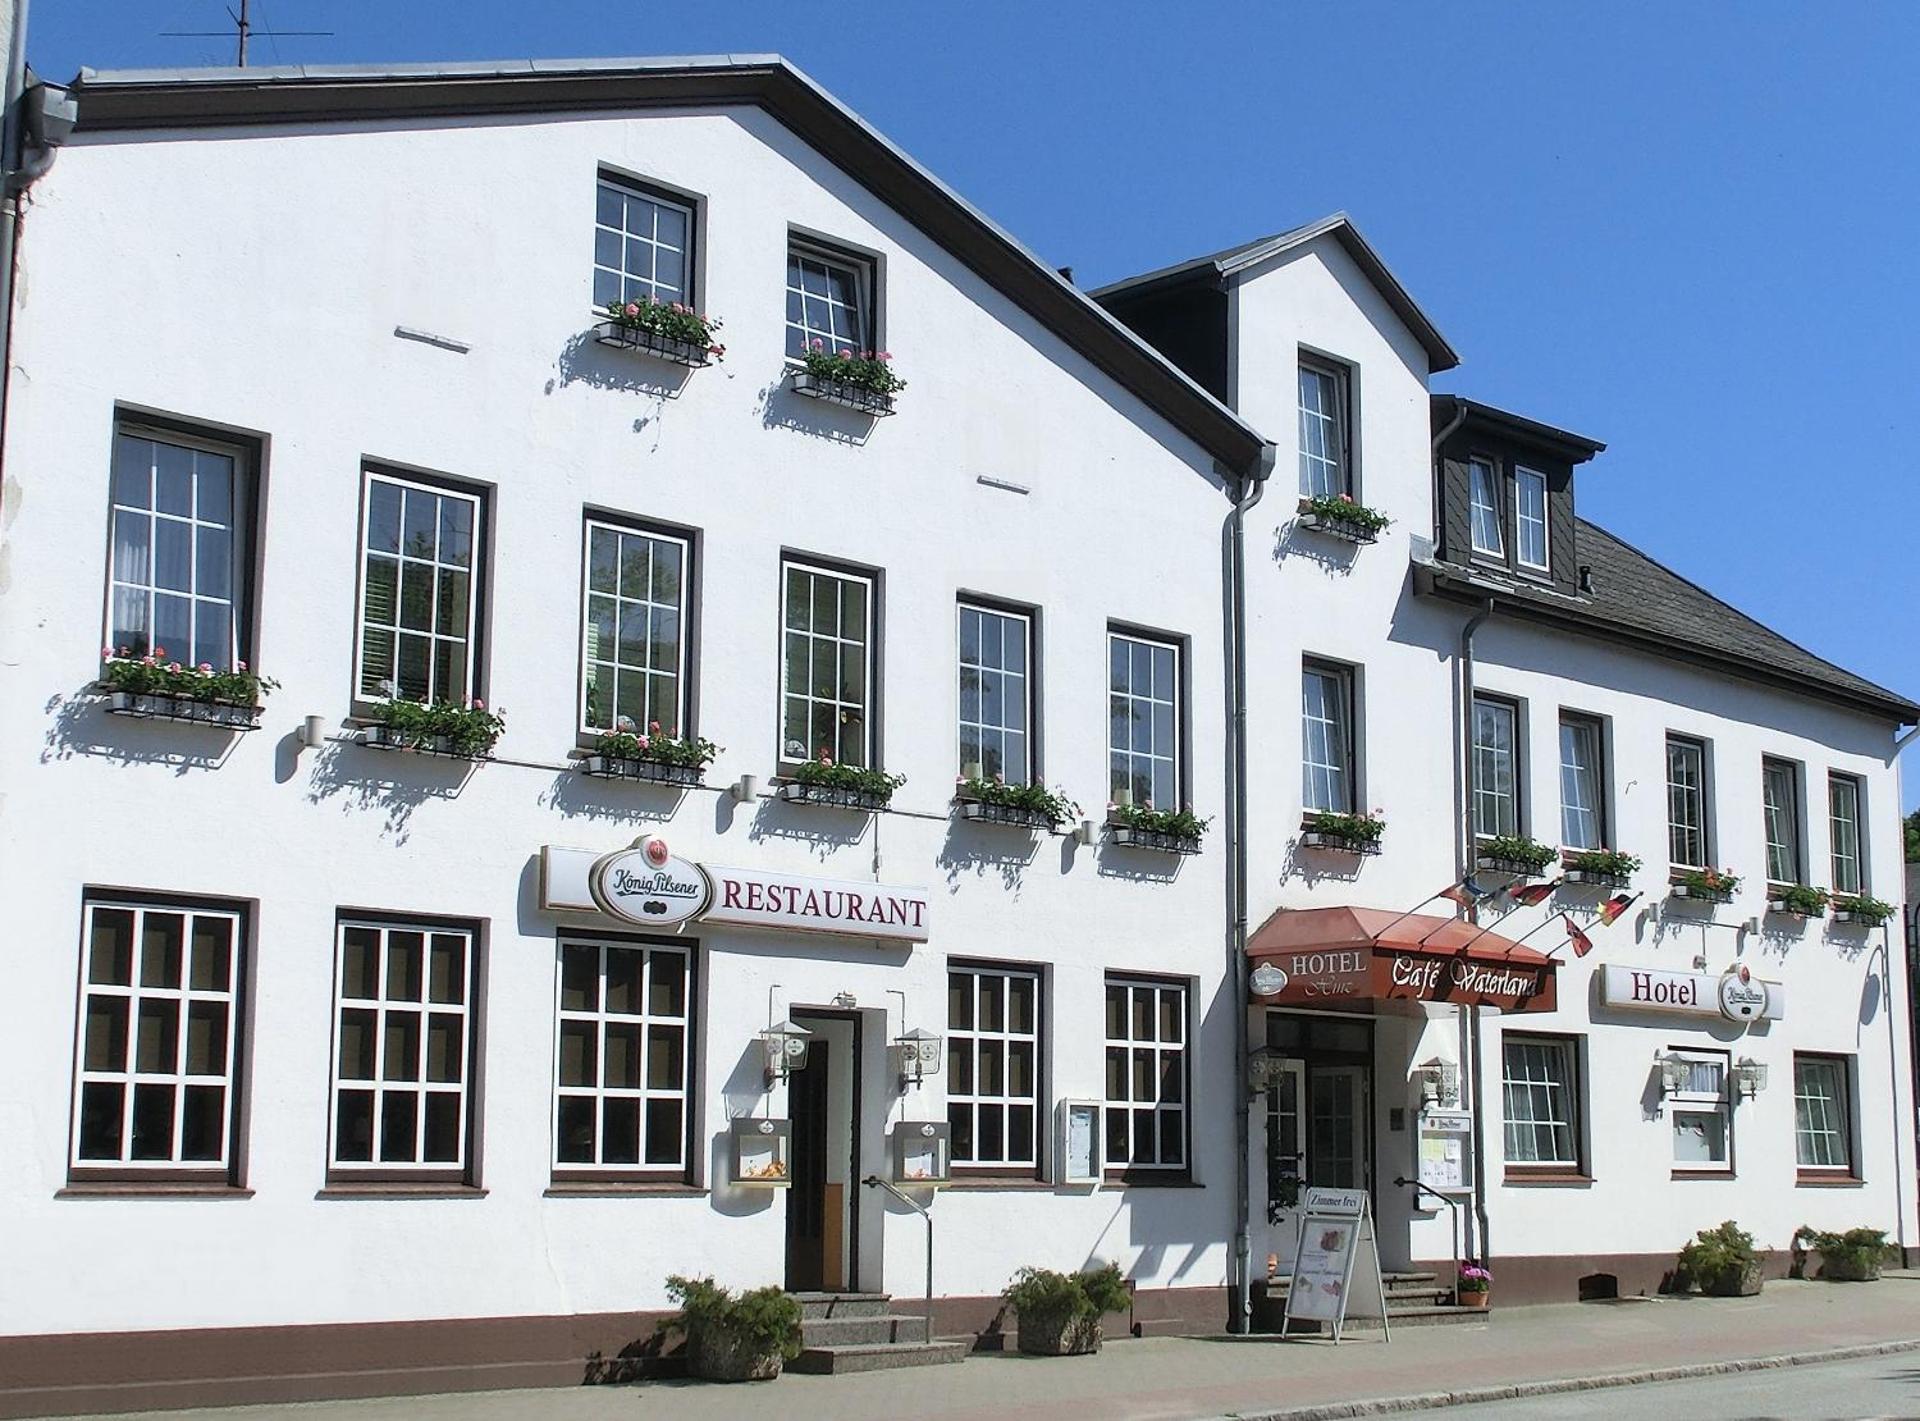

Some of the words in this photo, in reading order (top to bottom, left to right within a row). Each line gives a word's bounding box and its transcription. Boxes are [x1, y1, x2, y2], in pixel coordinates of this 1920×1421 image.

[613, 869, 653, 894] König
[652, 872, 699, 894] Pilsener
[722, 879, 926, 927] RESTAURANT
[1291, 951, 1367, 976] HOTEL
[1392, 955, 1442, 998] Café
[1631, 972, 1697, 1006] Hotel
